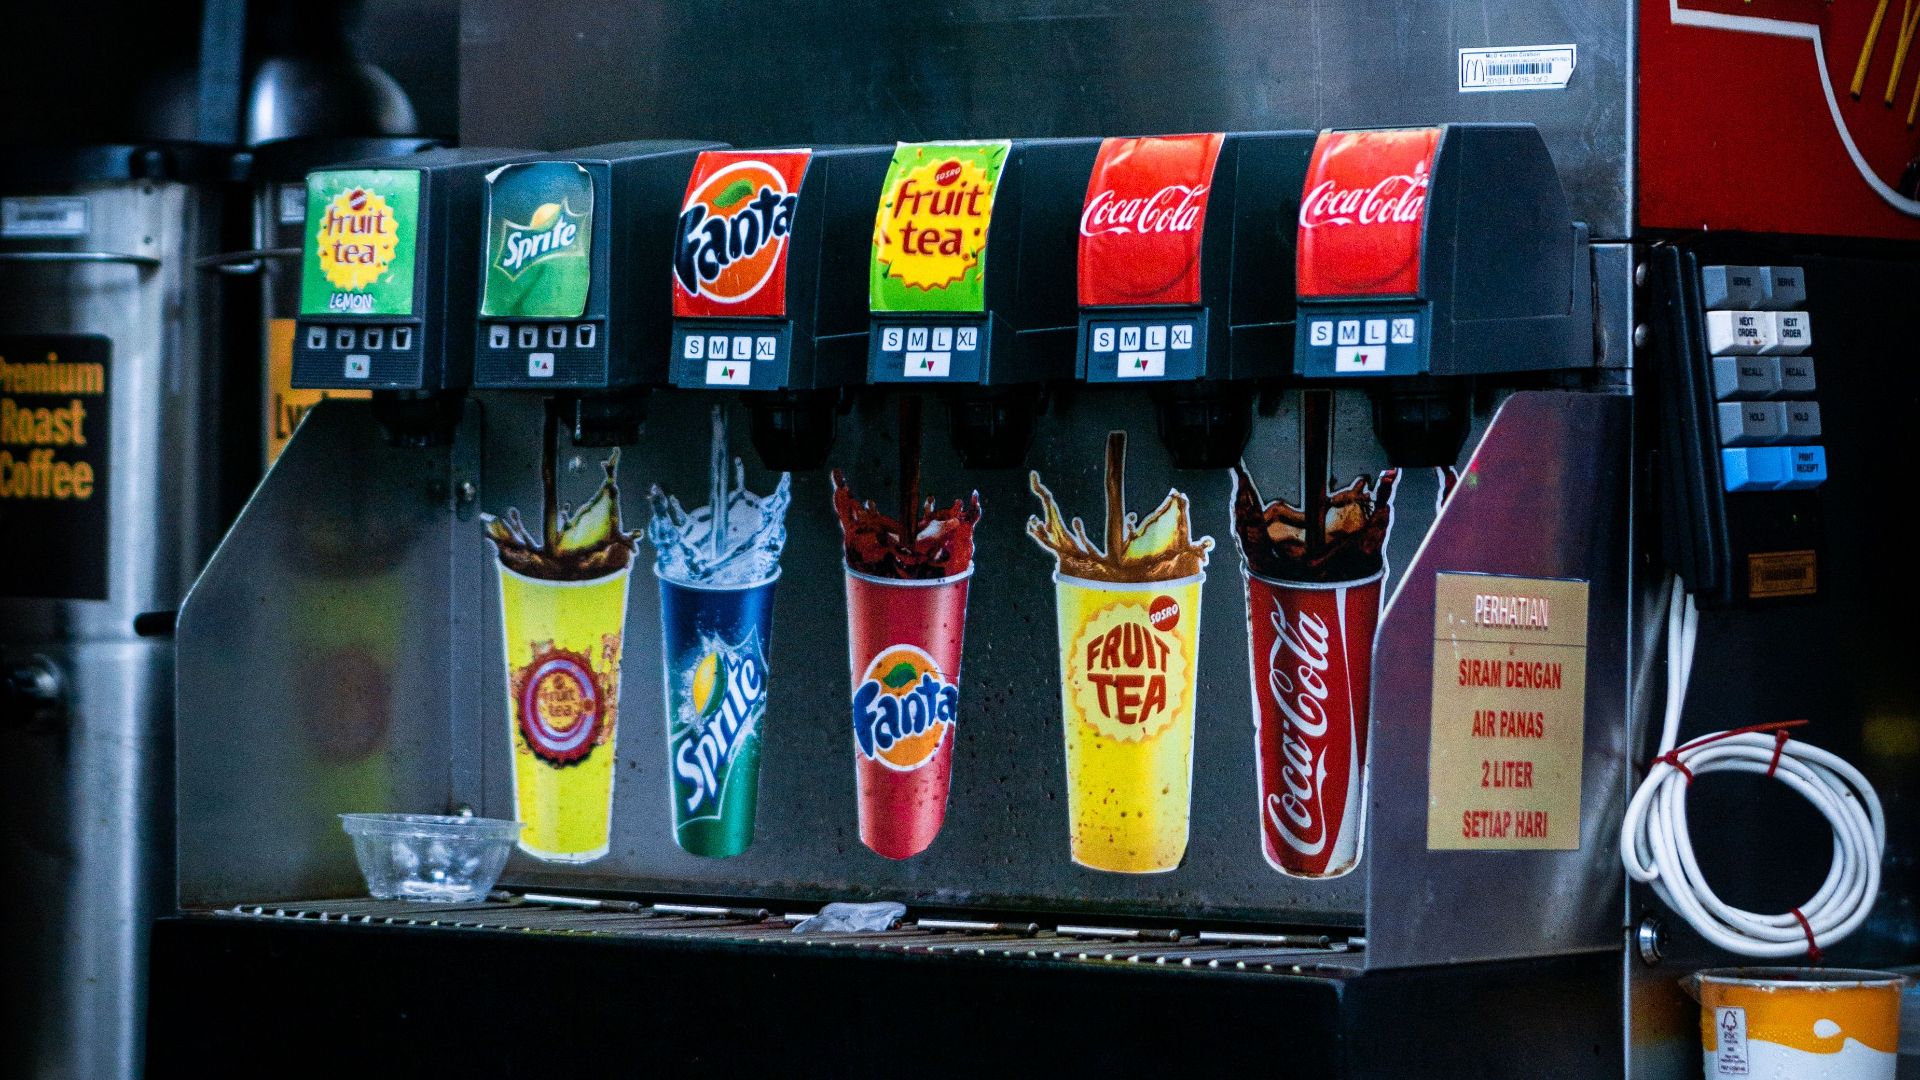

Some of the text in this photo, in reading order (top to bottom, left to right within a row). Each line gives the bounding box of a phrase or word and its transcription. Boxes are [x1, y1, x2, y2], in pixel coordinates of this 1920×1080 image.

[936, 166, 961, 181] SOSRO
[894, 178, 984, 219] fruit
[1080, 183, 1210, 237] Coca-Cola
[1300, 172, 1428, 228] Coca-Cola
[327, 207, 387, 236] fruit
[333, 240, 375, 264] tea
[503, 216, 577, 269] Sprite
[674, 186, 798, 295] Fanta
[900, 220, 963, 255] tea
[329, 293, 374, 309] LEMON
[1316, 325, 1328, 341] S
[1343, 325, 1355, 340] M
[1393, 323, 1413, 339] XL
[1738, 329, 1757, 337] ORDER
[1739, 317, 1754, 326] NEXT
[1782, 329, 1801, 338] ORDER
[1783, 318, 1797, 327] NEXT
[690, 340, 700, 355] S
[712, 341, 725, 355] M
[758, 341, 776, 355] XL
[888, 332, 898, 346] S
[911, 332, 924, 346] M
[958, 331, 976, 346] XL
[1099, 332, 1109, 347] S
[1124, 331, 1136, 346] M
[1173, 330, 1191, 344] XL
[0, 399, 86, 445] Roast
[0, 449, 93, 498] Coffee
[1150, 603, 1179, 625] SOSRO
[1475, 594, 1549, 628] PERHATIAN
[1087, 621, 1170, 672] FRUIT
[1458, 658, 1562, 689] SIRAM DENGAN
[1087, 672, 1167, 725] TEA
[853, 673, 957, 758] Fanta
[1267, 595, 1330, 857] Coca-Cola
[1472, 710, 1544, 739] AIR PANAS
[676, 657, 762, 812] Sprite
[1481, 760, 1533, 789] 2 LITER
[1462, 810, 1547, 839] SETIAP HARI
